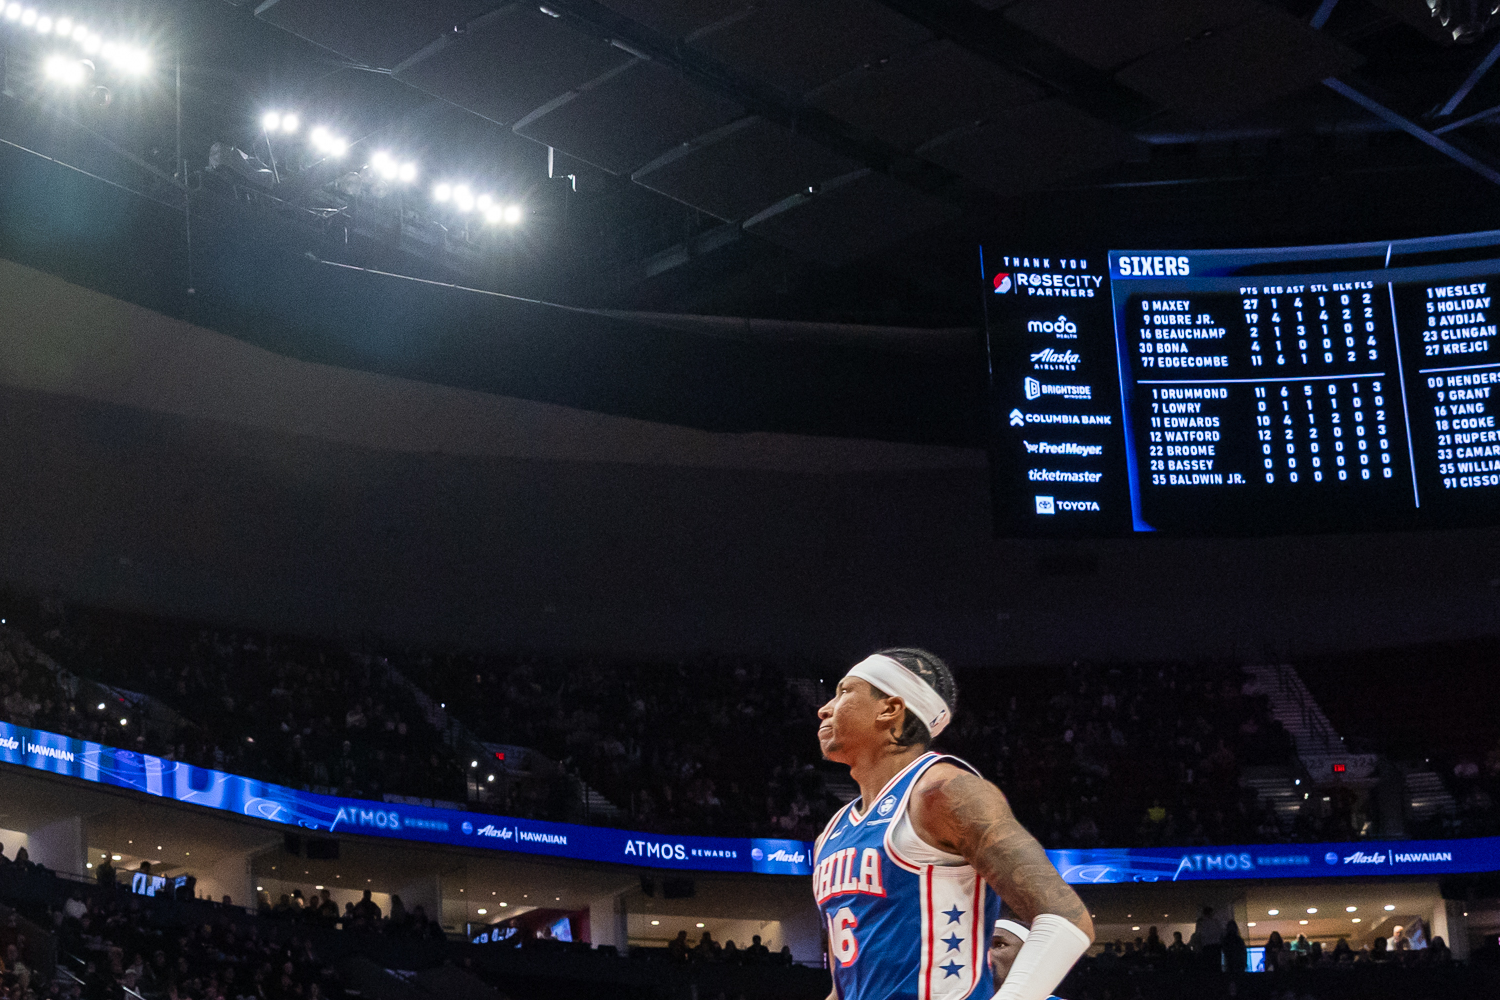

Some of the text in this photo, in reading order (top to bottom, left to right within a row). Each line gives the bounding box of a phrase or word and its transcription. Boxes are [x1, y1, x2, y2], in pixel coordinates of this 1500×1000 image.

[1003, 256, 1087, 269] THANK YOU
[1118, 256, 1190, 276] SIXERS
[1028, 287, 1094, 297] PARTNERS
[1240, 281, 1373, 295] PTS REB AST STL BLK FLS
[1427, 283, 1486, 299] 1 WESLEY
[1142, 293, 1371, 311] 0 MAXEY 27 1 4 1 0 2
[1426, 297, 1491, 313] 5 HOLIDAY
[1027, 315, 1077, 333] moda
[1143, 314, 1214, 325] 9 OUBRE JR.
[1428, 312, 1486, 327] 8 AVDIJA
[1140, 328, 1226, 339] 16 BEAUCHAMP
[1423, 325, 1497, 342] 23 CLINGAN
[1139, 342, 1188, 353] 30 BONA
[1425, 340, 1488, 356] 27 KREJCI
[1141, 356, 1229, 368] 77 EDGECOMBE
[1427, 377, 1444, 388] 00
[1042, 385, 1092, 395] BRIGHTSIDE
[1152, 388, 1228, 399] 1 DRUMMOND
[1437, 387, 1490, 402] 9 GRANT
[1152, 402, 1201, 414] 7 LOWRY
[1434, 402, 1484, 417] 16 YANG
[1025, 413, 1112, 425] COLUMBIA BANK
[1151, 417, 1220, 428] 11 EDWARDS
[1436, 416, 1495, 431] 18 COOKE
[1150, 431, 1220, 442] 12 WATFORD
[1438, 434, 1451, 446] 21
[1150, 445, 1215, 456] 22 BROOME
[1438, 449, 1453, 460] 33
[1150, 459, 1213, 471] 28 BASSEY
[1439, 463, 1455, 474] 35
[1028, 468, 1102, 482] ticketmaster
[1152, 473, 1246, 485] 35 BALDWIN JR.
[1444, 474, 1500, 489] 91 CISSO
[1056, 501, 1100, 511] TOYOTA
[27, 742, 74, 762] HAWAIIAN
[520, 831, 567, 845] HAWAIIAN
[624, 840, 805, 863] ATMOS REWARDS Alaska
[1395, 852, 1452, 863] HAWAIIAN
[826, 907, 858, 967] 6
